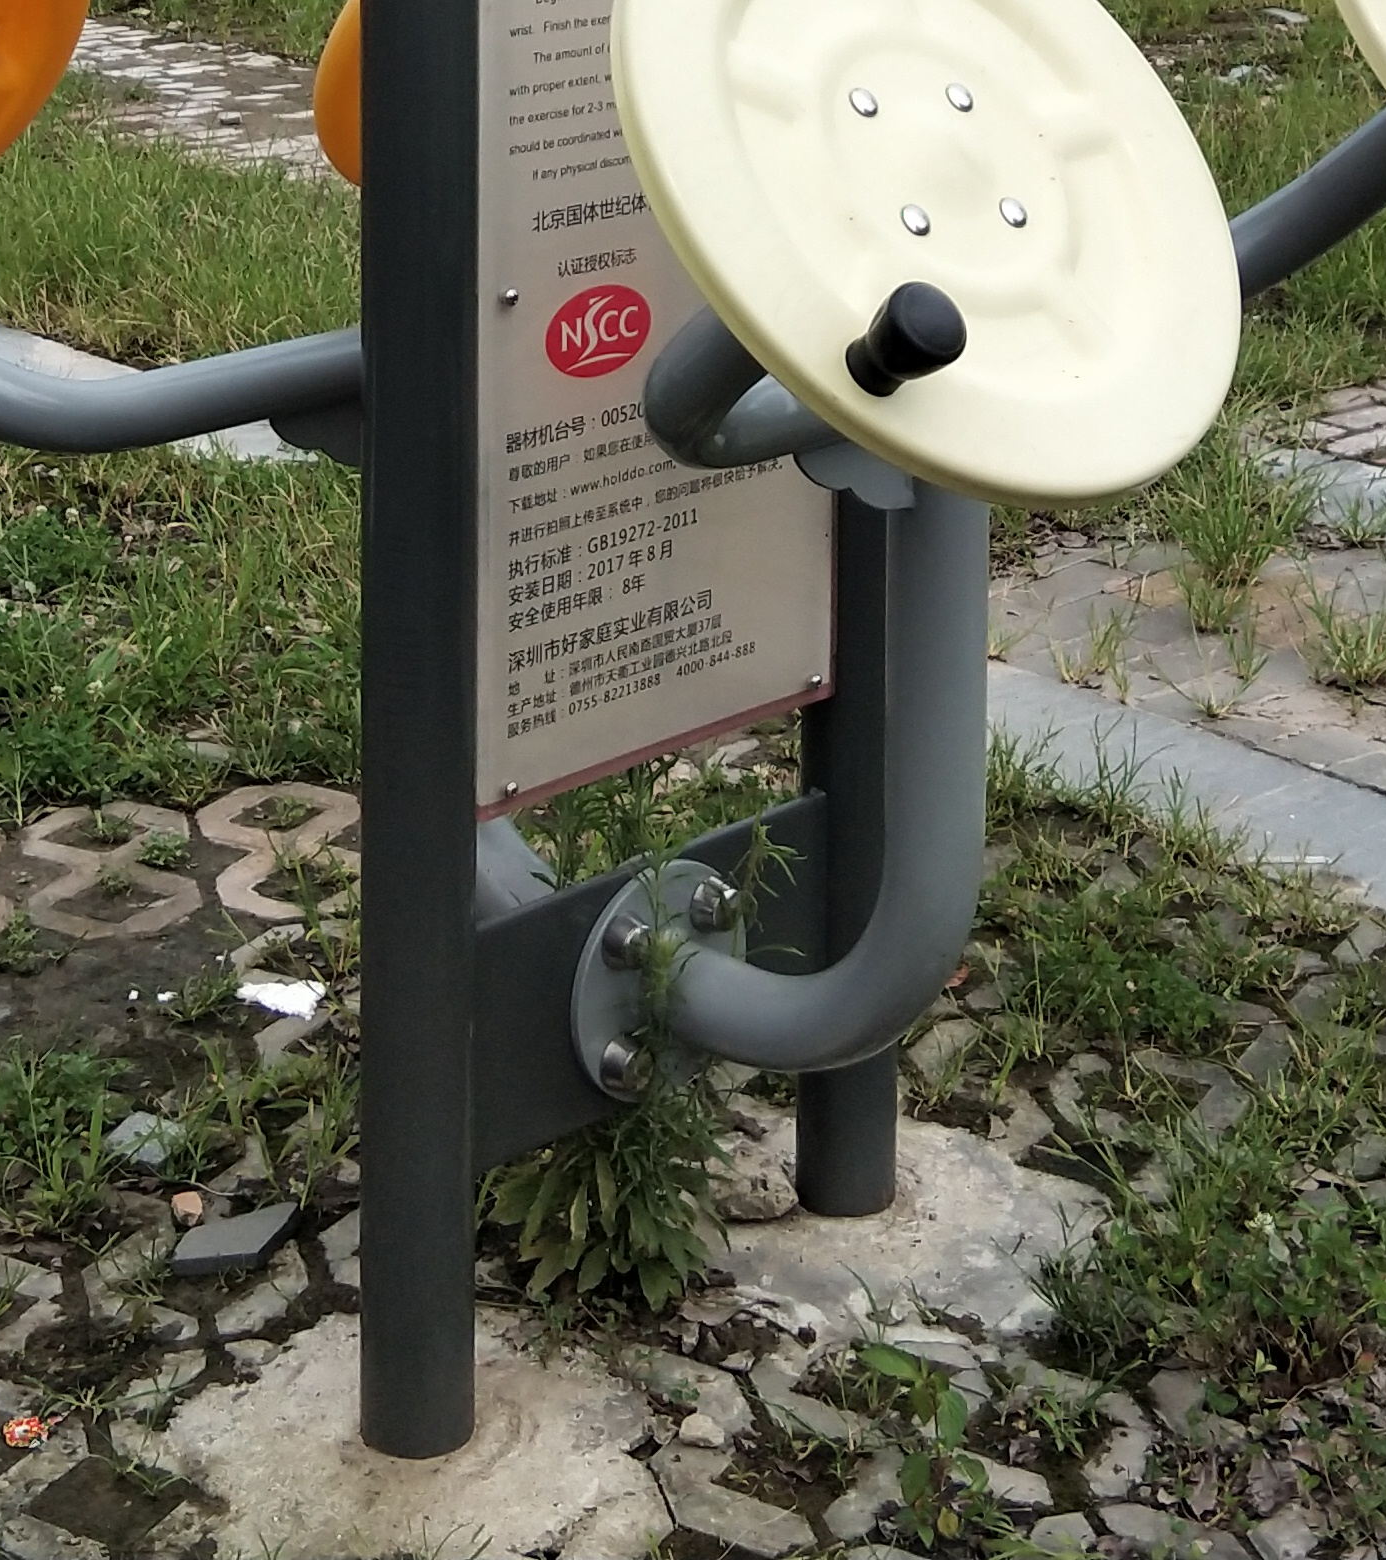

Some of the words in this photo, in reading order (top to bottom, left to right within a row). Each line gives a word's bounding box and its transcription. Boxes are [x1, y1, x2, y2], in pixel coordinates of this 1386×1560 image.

[543, 18, 571, 33] Finish
[574, 17, 589, 28] the
[533, 51, 552, 64] The
[555, 45, 593, 61] amount
[595, 43, 605, 55] of
[509, 82, 530, 96] with
[533, 79, 566, 95] proper
[509, 115, 525, 127] the
[527, 107, 569, 123] exercise
[571, 104, 585, 116] for
[587, 101, 604, 113] 2-3
[509, 140, 541, 156] should
[543, 139, 555, 150] be
[556, 128, 611, 147] coordinated
[541, 166, 558, 180] any
[560, 160, 598, 177] physical
[531, 191, 652, 233] 北京国体世纪体
[557, 247, 637, 278] 认证授权标志
[561, 295, 639, 362] NSCC
[509, 589, 712, 674] 深圳市好家庭实业有限公司
